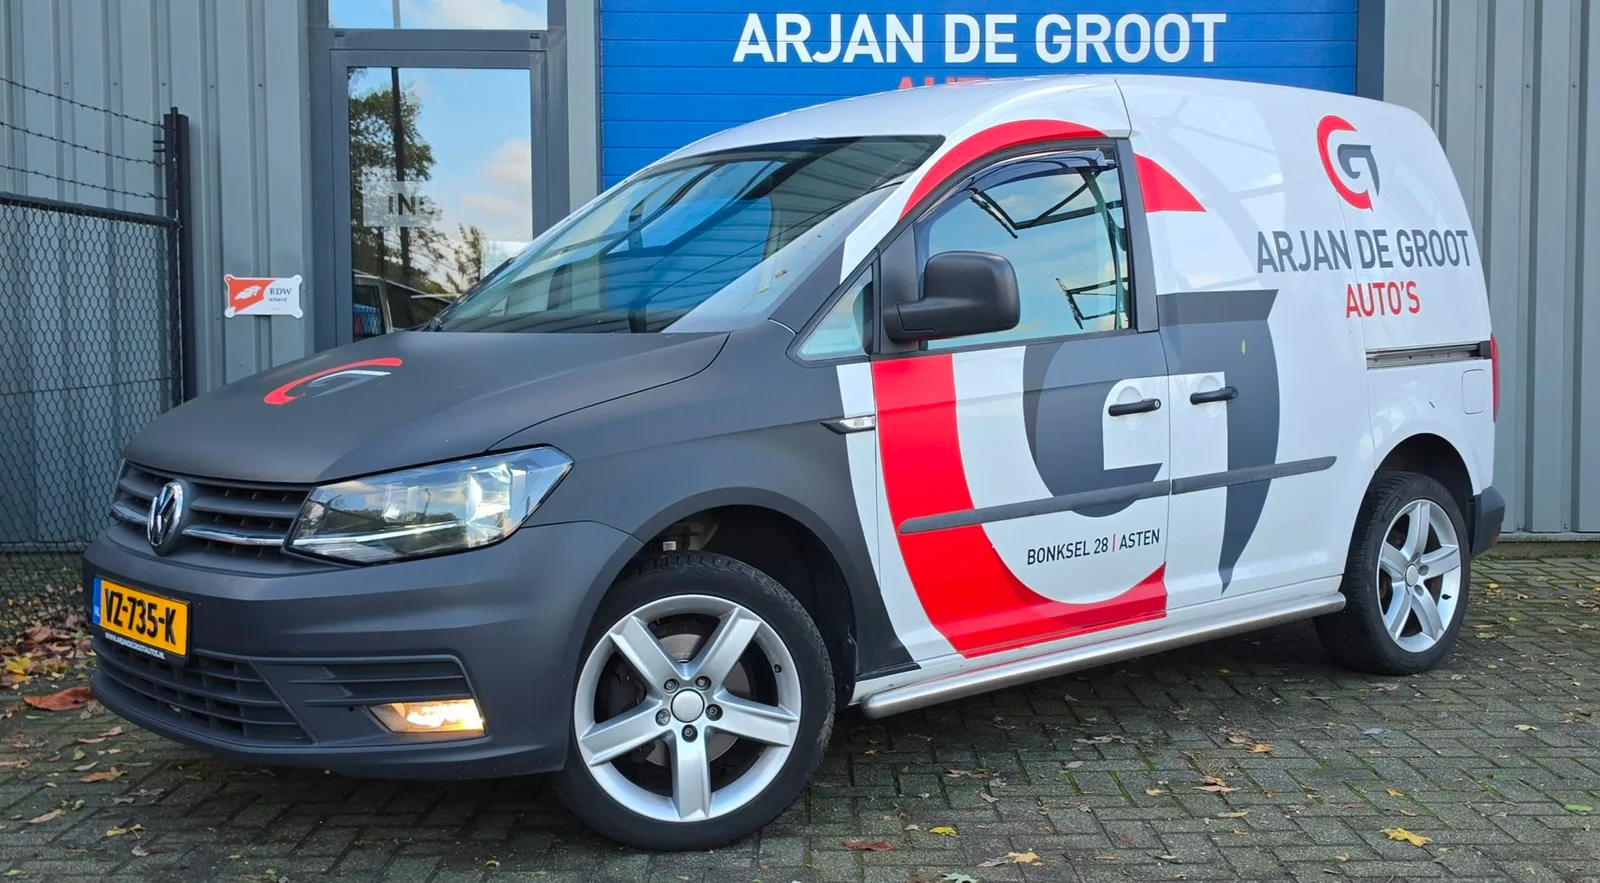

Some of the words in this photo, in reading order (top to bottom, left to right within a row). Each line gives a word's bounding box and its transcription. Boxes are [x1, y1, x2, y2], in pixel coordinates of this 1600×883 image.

[733, 13, 923, 63] ARJAN
[944, 13, 1017, 63] DE
[1035, 13, 1227, 63] GROOT
[1257, 229, 1353, 273] ARJAN
[1354, 229, 1394, 269] DE
[1396, 229, 1471, 268] GROOT
[269, 287, 292, 296] RDW
[1345, 280, 1421, 318] AUTO'S
[1027, 540, 1090, 566] BONKSEL
[1093, 537, 1109, 555] 28
[1119, 528, 1161, 551] ASTEN
[104, 588, 177, 646] VZ-735-K
